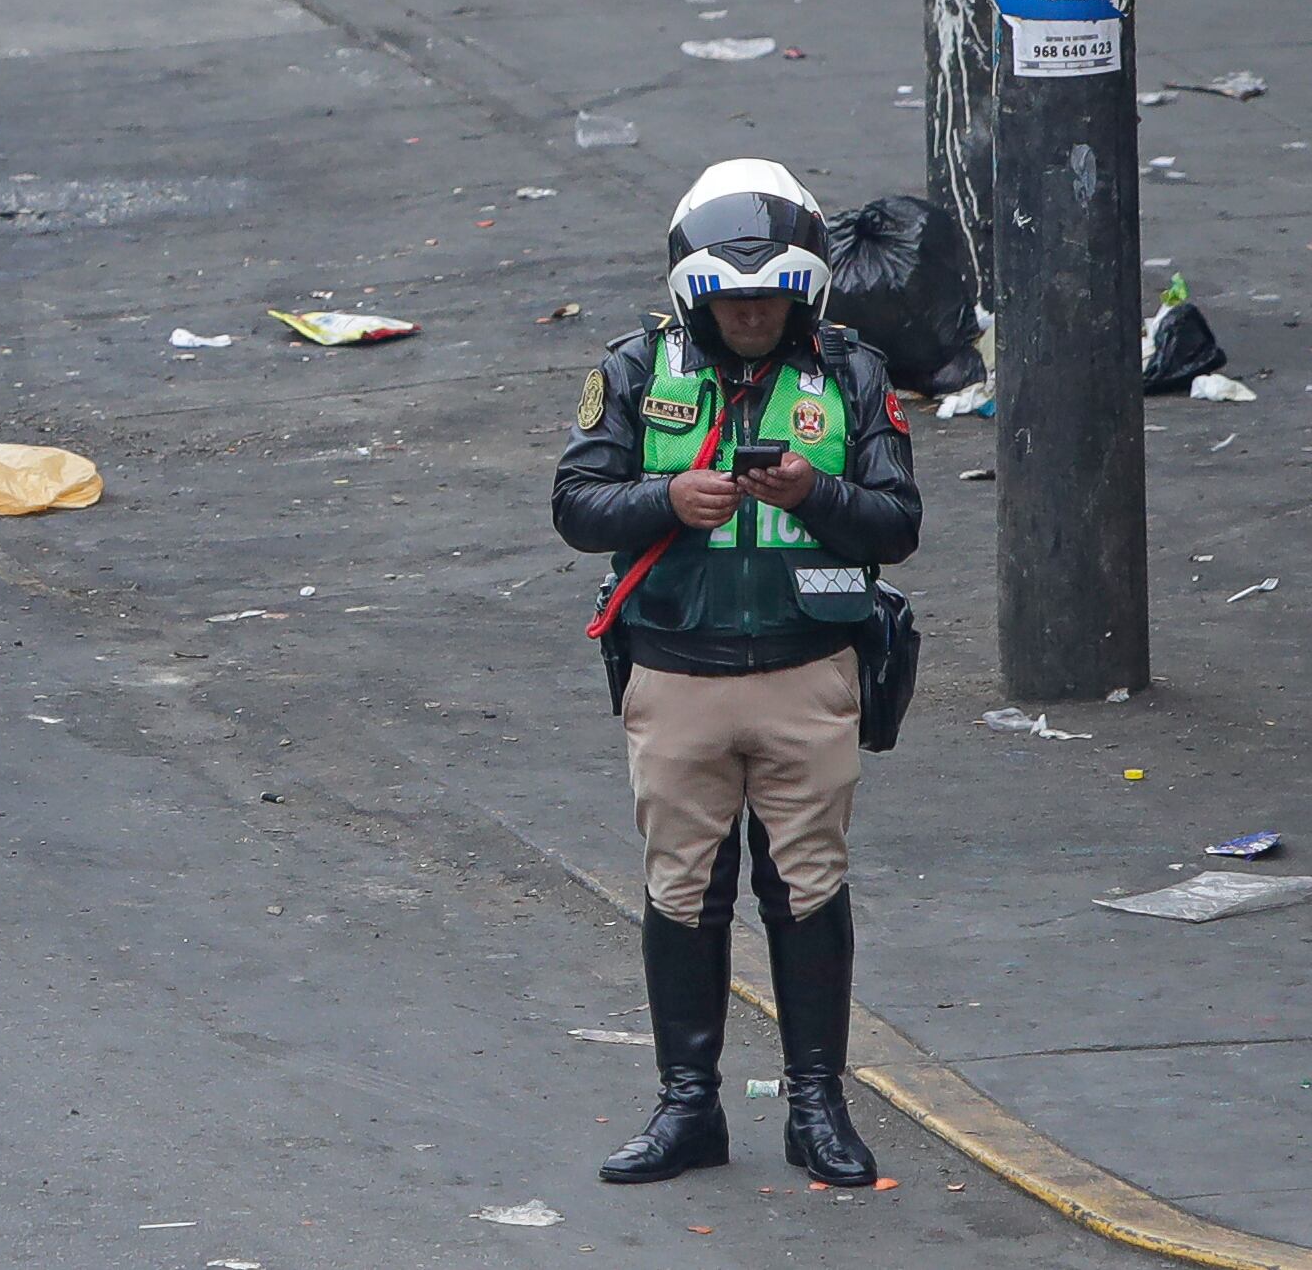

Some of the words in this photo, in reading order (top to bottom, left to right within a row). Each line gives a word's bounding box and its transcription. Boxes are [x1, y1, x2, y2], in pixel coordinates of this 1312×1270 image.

[1033, 45, 1058, 58] 968
[1062, 44, 1087, 58] 640
[1090, 41, 1112, 55] 423
